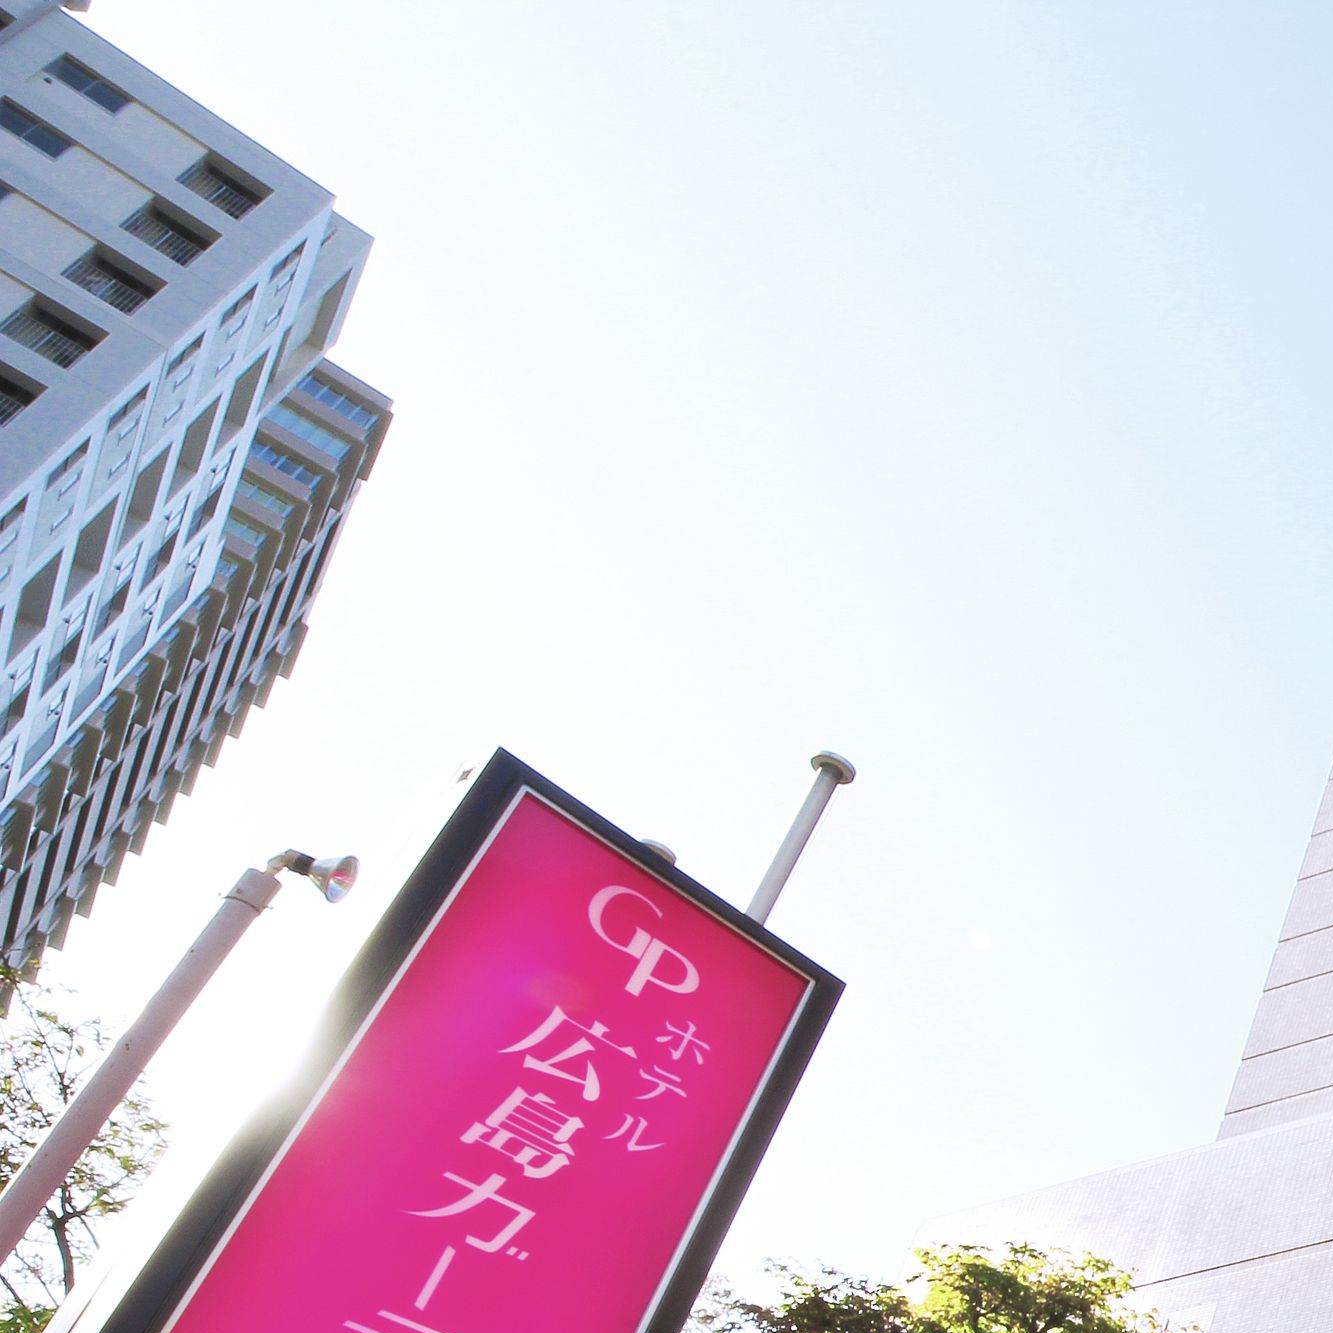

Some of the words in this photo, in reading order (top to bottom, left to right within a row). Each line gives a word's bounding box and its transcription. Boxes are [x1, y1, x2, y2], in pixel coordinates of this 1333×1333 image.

[588, 885, 700, 997] GP
[602, 1020, 711, 1152] ホテル
